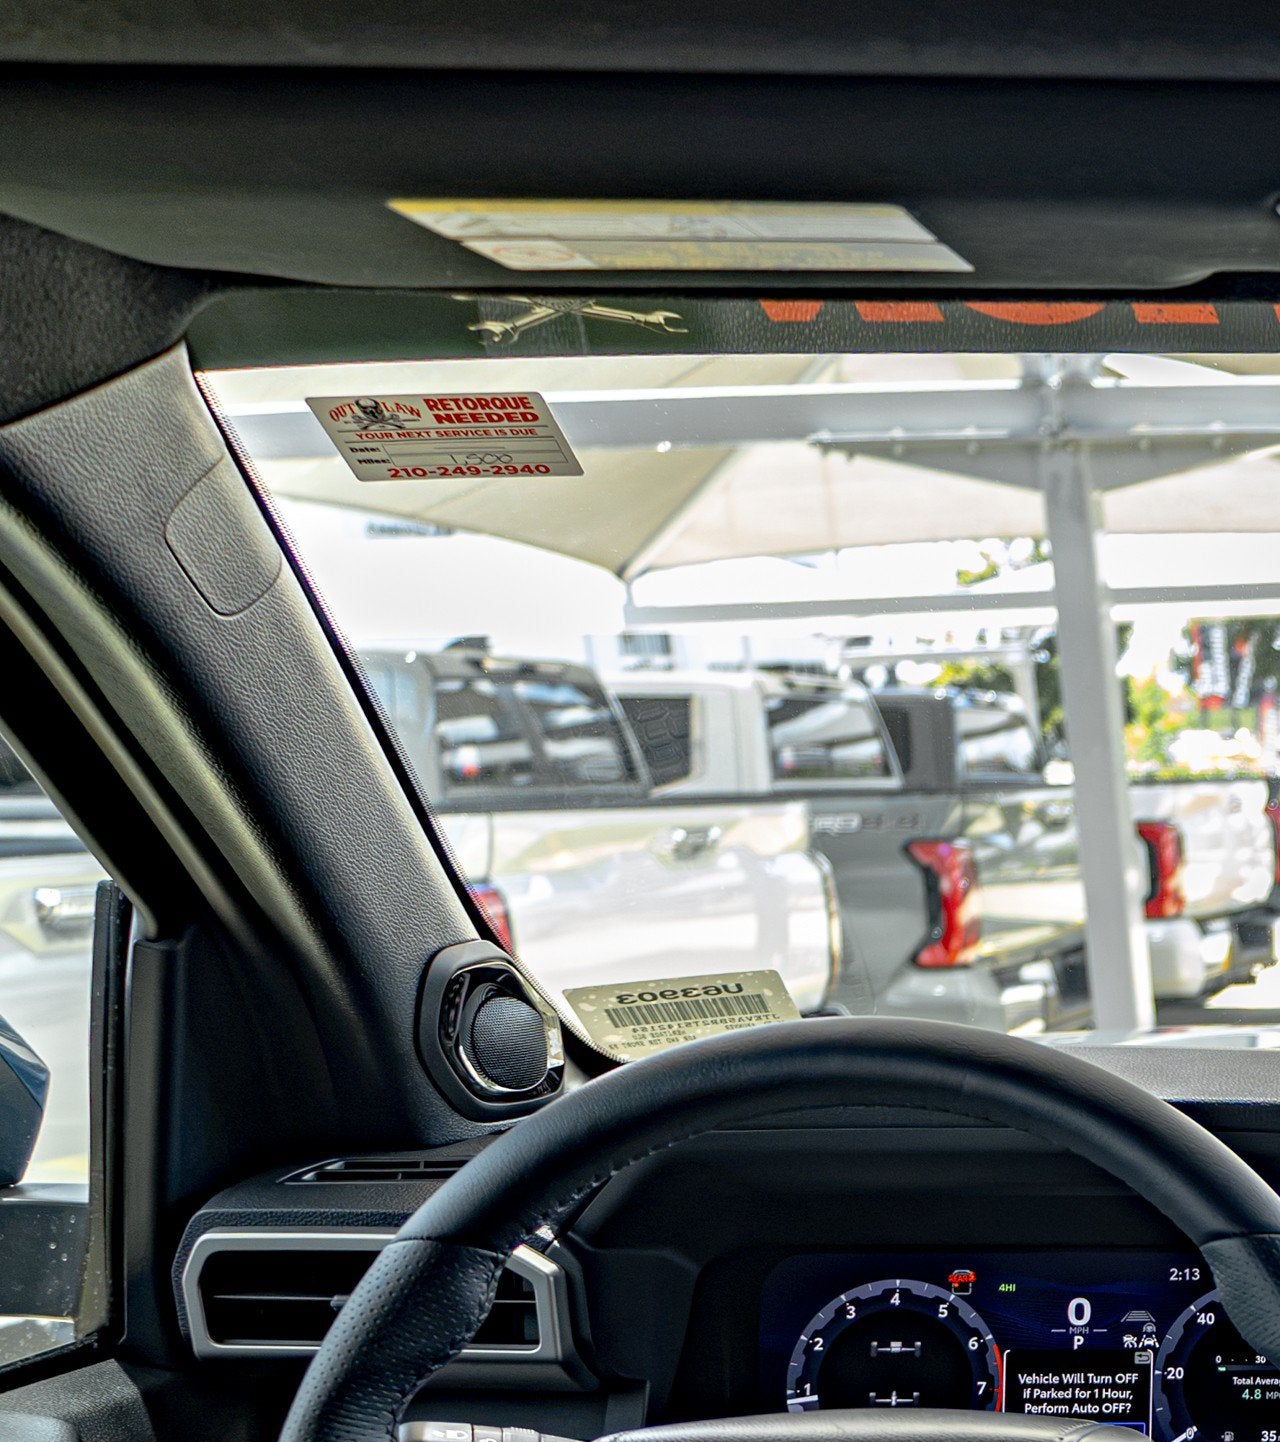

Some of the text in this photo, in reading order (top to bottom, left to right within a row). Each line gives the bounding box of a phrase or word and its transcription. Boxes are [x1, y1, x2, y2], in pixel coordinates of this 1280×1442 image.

[423, 396, 534, 411] RETORQUE
[432, 412, 539, 425] NEEDED
[356, 428, 537, 440] YOUR NEXT SERVICE IS DUE
[387, 464, 551, 478] 210-249-2940
[1169, 1268, 1200, 1281] 2:13
[999, 1283, 1016, 1292] 4HI
[890, 1293, 900, 1306] 4
[846, 1306, 856, 1319] 3
[938, 1304, 948, 1317] 5
[1067, 1297, 1092, 1326] 0
[1197, 1312, 1215, 1325] 40
[1069, 1327, 1089, 1335] MPH
[814, 1337, 824, 1351] 2
[968, 1337, 979, 1350] 6
[1073, 1335, 1085, 1350] P
[1018, 1373, 1139, 1384] Vehicle Will Turn OFF
[1166, 1367, 1184, 1379] 20
[1232, 1377, 1253, 1385] Total
[804, 1384, 811, 1396] 1
[977, 1381, 987, 1395] 7
[1242, 1389, 1261, 1400] 4.8
[1023, 1388, 1134, 1402] if Parked for 1 Hour,
[1025, 1403, 1131, 1414] Perform Auto OFF?
[1261, 1431, 1277, 1441] 35
